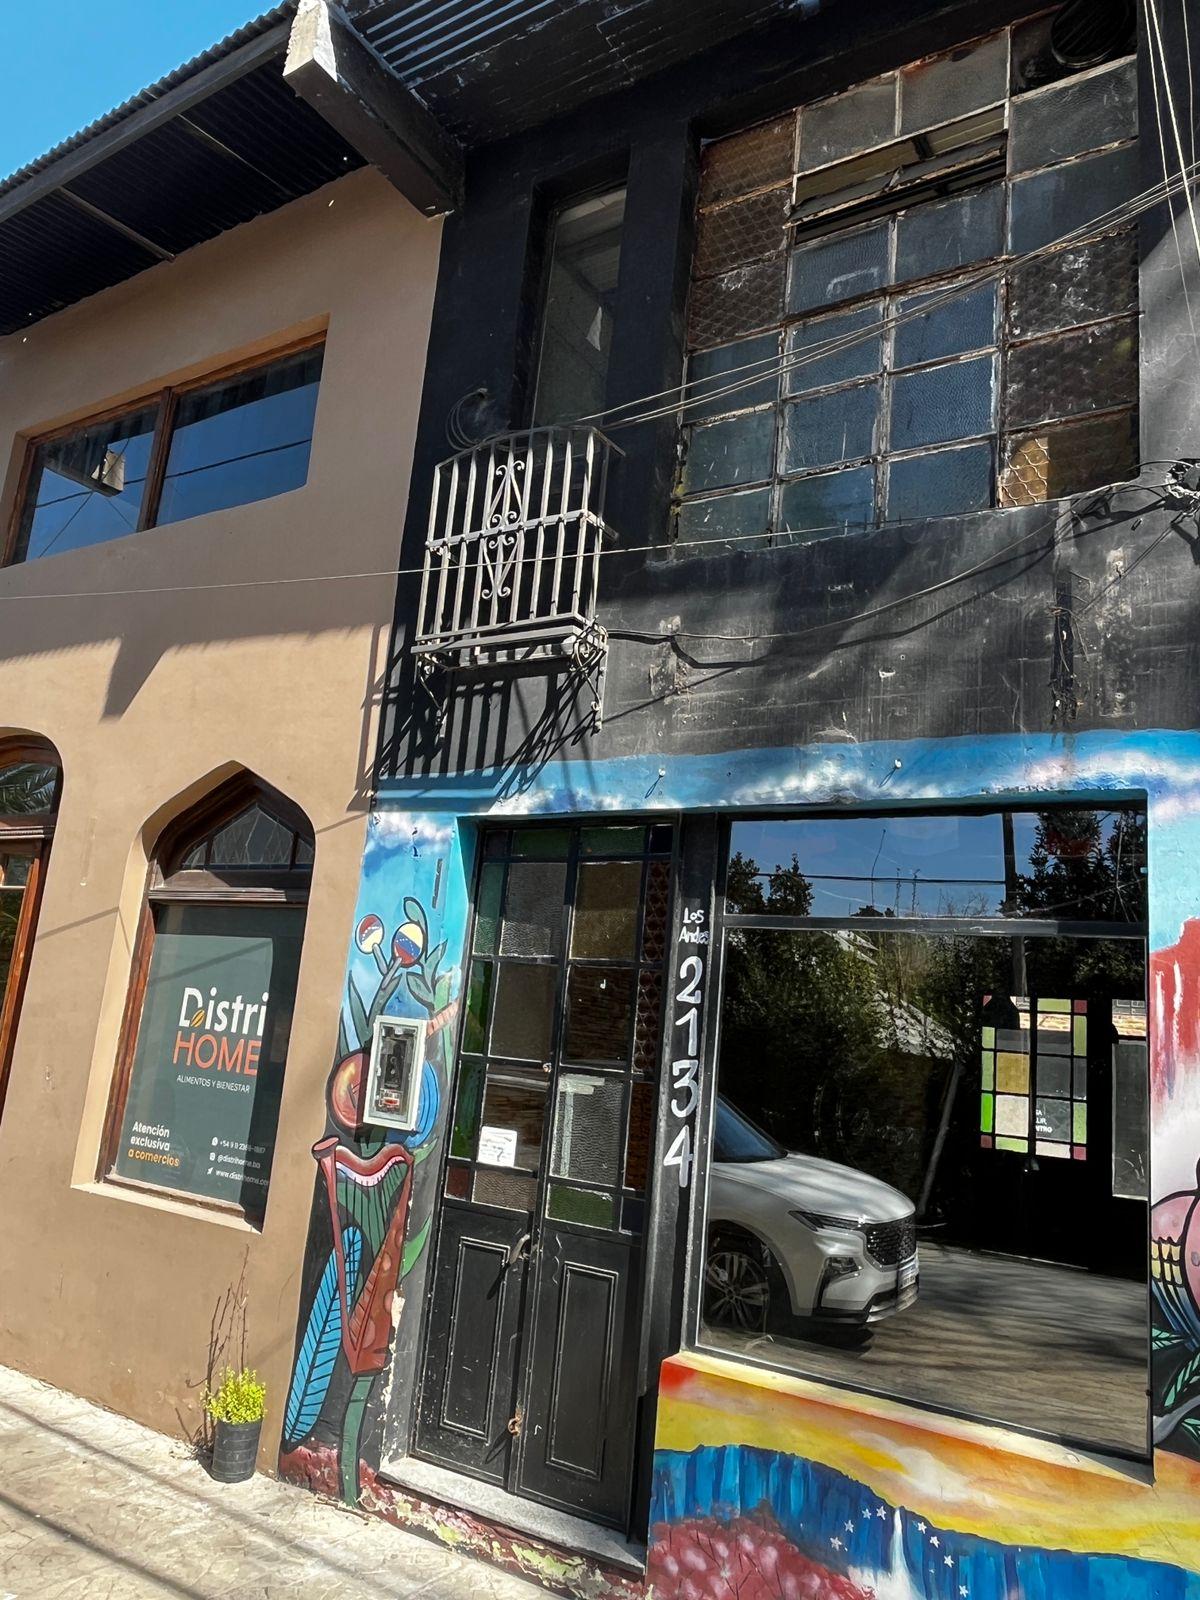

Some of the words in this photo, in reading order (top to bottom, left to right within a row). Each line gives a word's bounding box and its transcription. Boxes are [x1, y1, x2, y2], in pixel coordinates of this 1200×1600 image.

[178, 986, 269, 1037] Distri
[172, 1030, 262, 1076] HOME
[663, 956, 703, 1188] 2134
[176, 1074, 212, 1088] ALIMENTOS
[211, 1079, 217, 1088] Y
[216, 1080, 251, 1094] BIENESTAR
[132, 1121, 170, 1138] Atención
[130, 1135, 171, 1152] exclusiva
[127, 1148, 135, 1158] a
[134, 1150, 181, 1168] comercios
